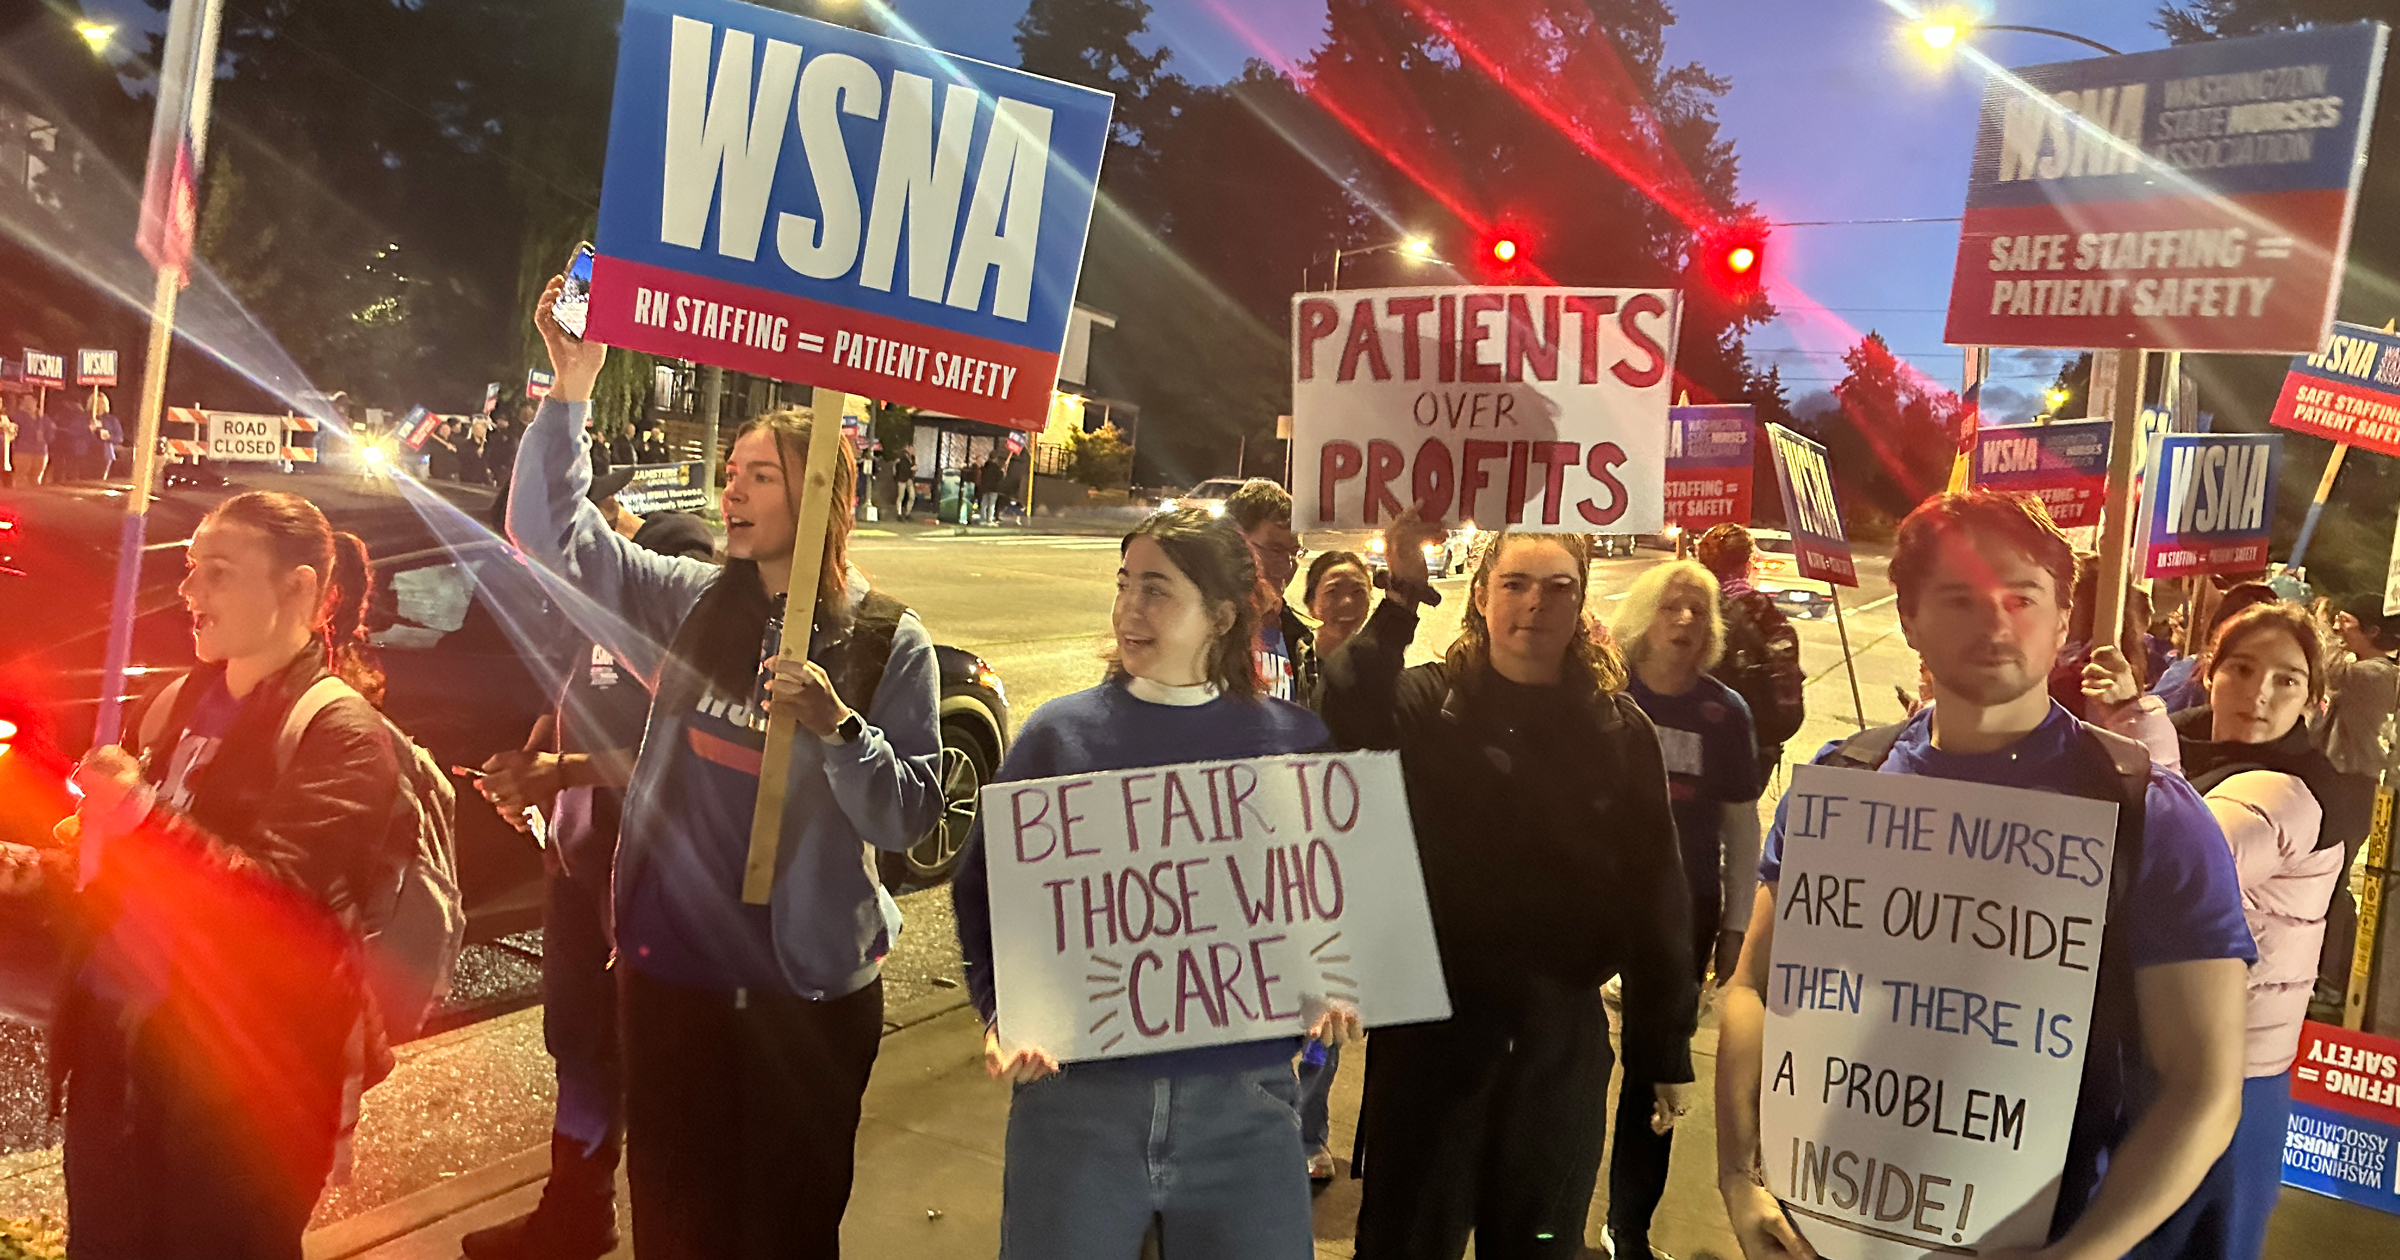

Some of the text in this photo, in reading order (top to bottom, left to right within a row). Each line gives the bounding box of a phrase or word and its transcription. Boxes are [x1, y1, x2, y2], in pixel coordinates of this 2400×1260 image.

[1999, 83, 2148, 181] WSNA
[2158, 96, 2344, 140] STATE NURSES
[661, 15, 1053, 322] WSNA
[1988, 234, 2068, 271] SAFE
[2074, 228, 2247, 270] STAFFING
[1991, 276, 2274, 317] PATIENT SAFETY
[634, 287, 669, 329] RN
[673, 296, 788, 353] STAFFING
[833, 330, 929, 382] PATIENT
[931, 351, 1017, 400] SAFETY
[1299, 293, 1666, 387] PATIENTS
[27, 352, 63, 379] WSNA
[83, 352, 115, 376] WSNA
[1413, 391, 1518, 429] OVER
[2296, 385, 2334, 407] SAFE
[224, 420, 267, 436] ROAD
[2294, 404, 2356, 433] PATIENT
[214, 439, 276, 455] CLOSED
[1982, 437, 2038, 474] WSNA
[1319, 436, 1628, 525] PROFITS
[2166, 445, 2270, 534] WSNA
[1687, 499, 1735, 516] SAFETY
[1011, 759, 1360, 863] BE FAIR TO
[1793, 794, 2106, 887] IF THE NURSES
[1043, 838, 1344, 953] THOSE WHO
[1783, 872, 2092, 972] ARE OUTSIDE
[1129, 934, 1300, 1038] CARE
[1776, 963, 2073, 1059] THEN THERE IS
[2307, 1039, 2398, 1079] SAFETY
[1772, 1051, 2026, 1150] A PROBLEM
[2285, 1131, 2385, 1171] STATE NURSE
[2288, 1113, 2388, 1153] ASSOCIATION
[2282, 1147, 2381, 1189] WASHINGTON
[1790, 1138, 1974, 1243] INSIDE!
